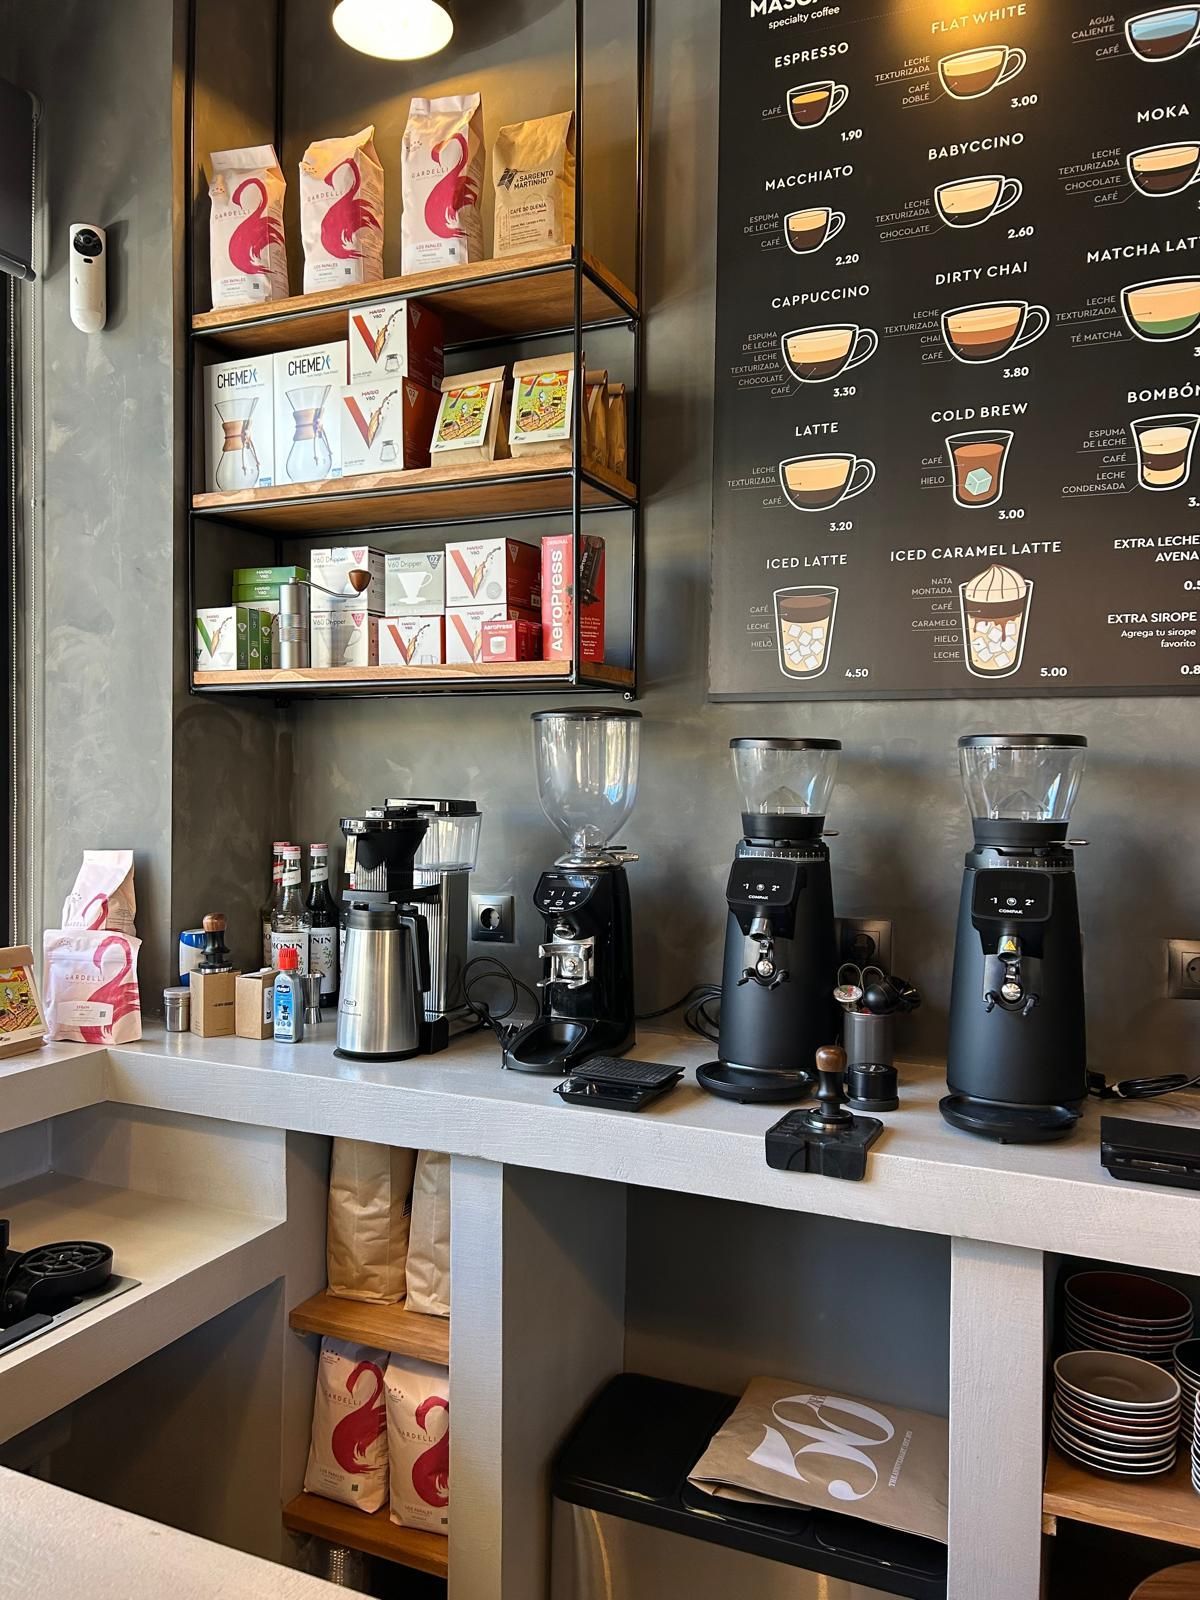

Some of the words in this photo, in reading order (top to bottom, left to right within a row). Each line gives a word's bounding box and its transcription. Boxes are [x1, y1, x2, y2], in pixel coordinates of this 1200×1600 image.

[768, 14, 809, 30] specialty
[811, 6, 840, 19] coffee
[931, 16, 968, 34] FLAT
[972, 4, 1027, 25] WHITE
[1089, 15, 1115, 26] AGUA
[1071, 25, 1115, 40] CALIENTE
[774, 42, 849, 68] ESPRESSO
[1096, 44, 1120, 57] CAFÉ
[904, 56, 931, 67] LECHE
[875, 65, 930, 82] TEXTURIZADA
[908, 82, 930, 94] CAFÉ
[902, 92, 930, 105] DOBLE
[1011, 94, 1038, 108] 3.00
[762, 105, 782, 117] CAFÉ
[1137, 103, 1190, 124] MOKA
[840, 128, 863, 141] 1.90
[928, 132, 1024, 160] BABYCCINO
[1092, 148, 1121, 160] LECHE
[1058, 158, 1120, 176] TEXTURIZADA
[520, 170, 554, 182] SARGENTO
[765, 164, 854, 191] MACCHIATO
[514, 178, 548, 190] MARTINHO
[1065, 176, 1121, 191] CHOCOLATE
[1094, 191, 1118, 204] CAFÉ
[904, 198, 931, 210] LECHE
[750, 212, 779, 224] ESPUMA
[875, 208, 930, 224] TEXTURIZADA
[744, 224, 754, 234] DE
[755, 220, 779, 232] LECHE
[880, 224, 930, 240] CHOCOLATE
[1007, 226, 1034, 240] 2.60
[761, 237, 780, 248] CAFÉ
[1087, 241, 1160, 264] MATCHA
[835, 254, 860, 266] 2.20
[936, 268, 982, 286] DIRTY
[986, 261, 1028, 279] CHAI
[771, 284, 870, 309] CAPPUCCINO
[1086, 296, 1116, 306] LECHE
[913, 308, 940, 319] LECHE
[1056, 306, 1118, 322] TEXTURIZADA
[884, 320, 939, 334] TEXTURIZADA
[748, 331, 778, 342] ESPUMA
[920, 334, 941, 344] CHAI
[1071, 332, 1082, 343] TÉ
[1084, 330, 1122, 342] MATCHA
[742, 342, 752, 350] DE
[753, 339, 777, 350] LECHE
[754, 352, 777, 362] LECHE
[922, 350, 944, 361] CAFÉ
[288, 354, 331, 376] CHEMEX
[730, 362, 780, 374] TEXTURIZADA
[217, 368, 258, 389] CHEMEX
[1002, 366, 1030, 379] 3.80
[738, 374, 784, 386] CHOCOLATE
[771, 385, 791, 395] CAFÉ
[833, 386, 856, 398] 3.30
[931, 408, 976, 424] COLD
[980, 402, 1028, 418] BREW
[795, 422, 840, 437] LATTE
[1089, 428, 1126, 438] ESPUMA
[1083, 440, 1095, 448] DE
[1097, 438, 1127, 447] LECHE
[922, 455, 943, 466] CAFÉ
[1102, 453, 1127, 464] CAFÉ
[752, 466, 776, 476] LECHE
[1096, 470, 1126, 480] LECHE
[728, 476, 776, 488] TEXTURIZADA
[920, 475, 945, 485] HIELO
[1062, 482, 1126, 494] CONDENSADA
[762, 496, 782, 506] CAFÉ
[998, 508, 1025, 520] 3.00
[829, 521, 853, 532] 3.20
[1114, 537, 1155, 550] EXTRA
[1158, 534, 1200, 548] LECHE
[890, 549, 926, 562] ICED
[931, 544, 1007, 560] CARAMEL
[1012, 541, 1062, 555] LATTE
[1155, 550, 1200, 564] AVENA
[766, 556, 800, 570] ICED
[804, 554, 848, 567] LATTE
[931, 577, 953, 586] NATA
[912, 586, 953, 596] MONTADA
[551, 550, 564, 652] AeroPress
[931, 602, 953, 611] CAFÉ
[750, 605, 768, 614] CAFÉ
[912, 618, 957, 628] CARAMELO
[1107, 613, 1148, 624] EXTRA
[1150, 611, 1198, 623] SIROPE
[746, 622, 770, 630] LECHE
[934, 634, 959, 643] HIELO
[1120, 628, 1154, 639] Agrega
[1156, 628, 1166, 636] tu
[1167, 627, 1197, 638] sirope
[751, 639, 773, 648] HIELO
[1160, 638, 1196, 648] favorito
[934, 651, 960, 660] LECHE
[845, 668, 869, 678] 4.50
[1040, 667, 1068, 678] 5.00
